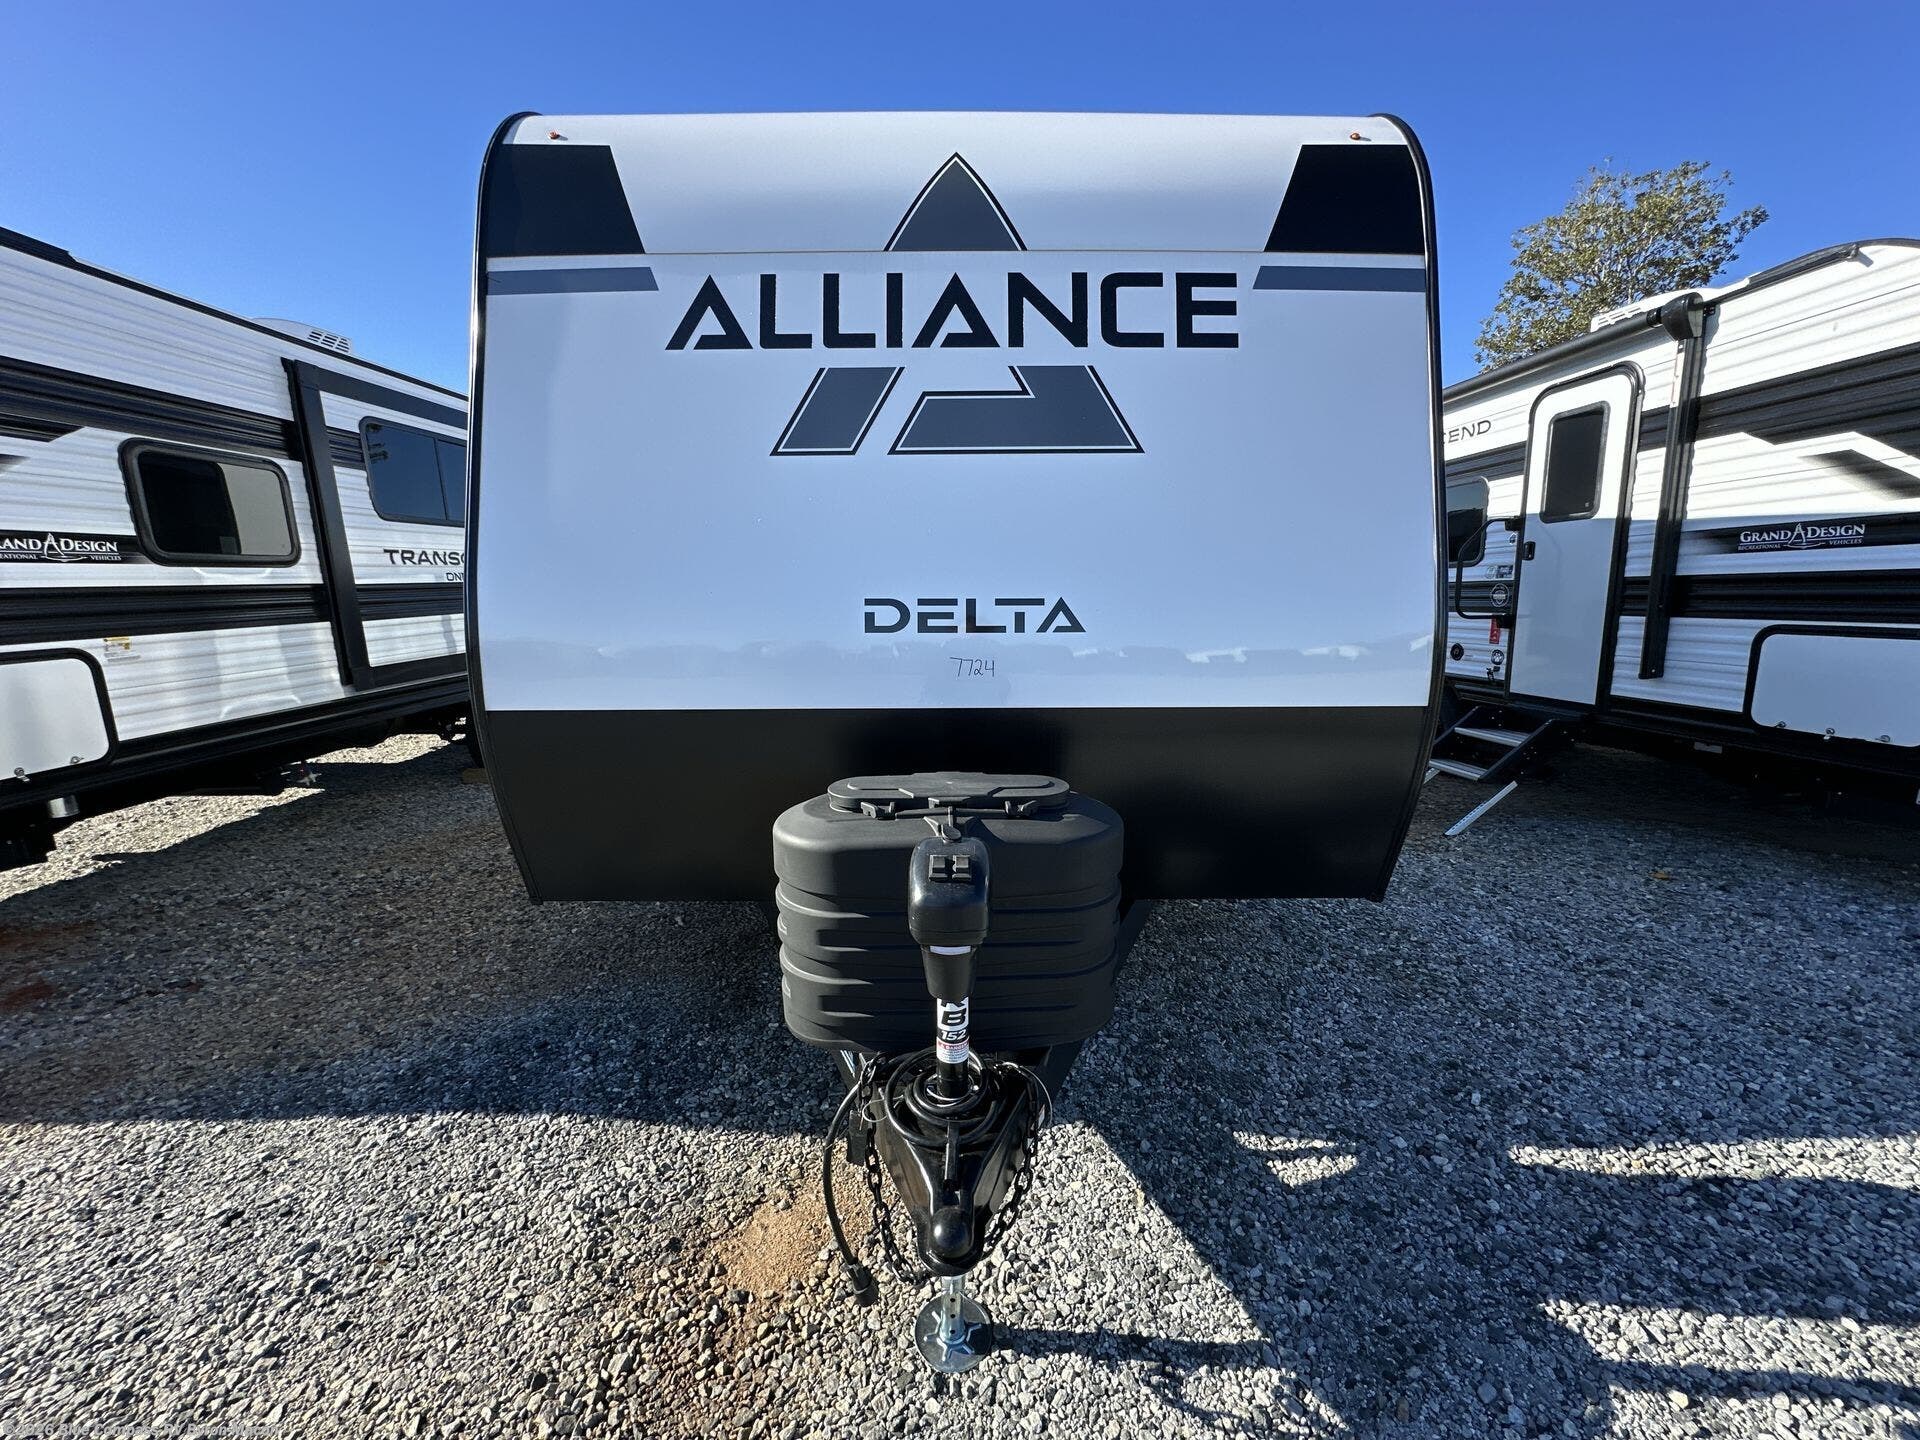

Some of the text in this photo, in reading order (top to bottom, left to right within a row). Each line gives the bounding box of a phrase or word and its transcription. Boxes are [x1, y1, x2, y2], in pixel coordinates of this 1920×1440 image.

[665, 271, 1240, 350] ALLIANCE
[1444, 419, 1491, 443] END
[1740, 524, 1866, 542] GRAND DESIGN
[59, 538, 118, 552] DESIGN
[864, 597, 1087, 633] DELTA
[950, 656, 996, 677] 7724
[941, 1028, 967, 1041] 152
